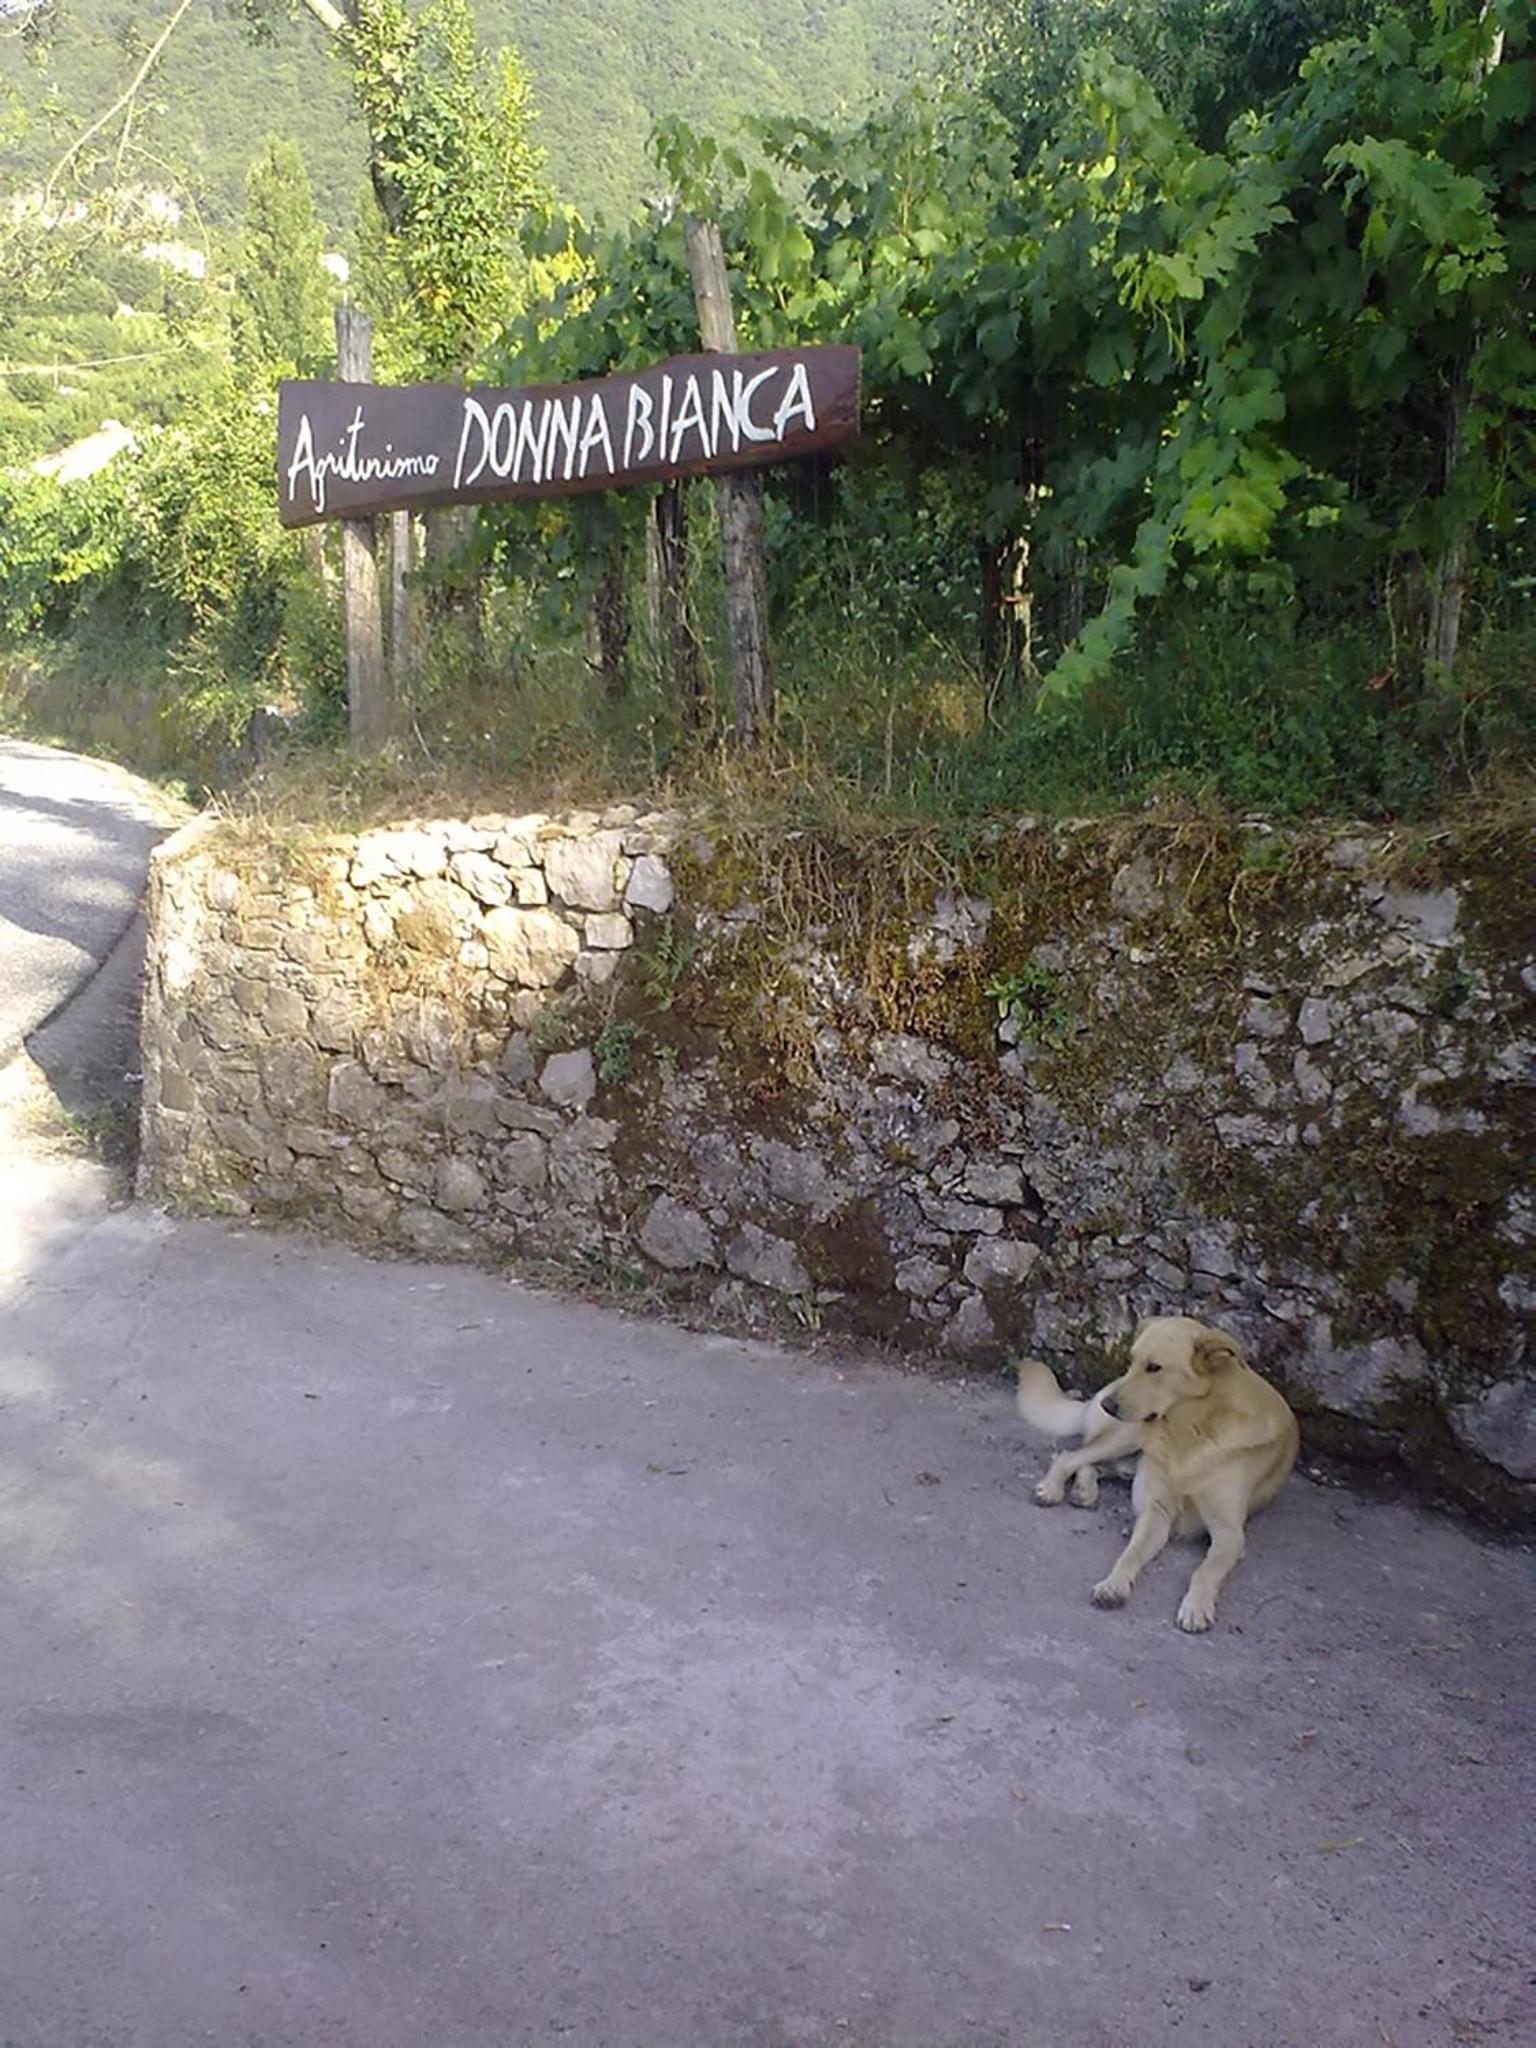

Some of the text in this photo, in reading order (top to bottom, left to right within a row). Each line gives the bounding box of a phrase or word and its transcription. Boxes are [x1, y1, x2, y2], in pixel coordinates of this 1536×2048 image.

[288, 362, 815, 513] Agriturismo DONNA BIANCA
